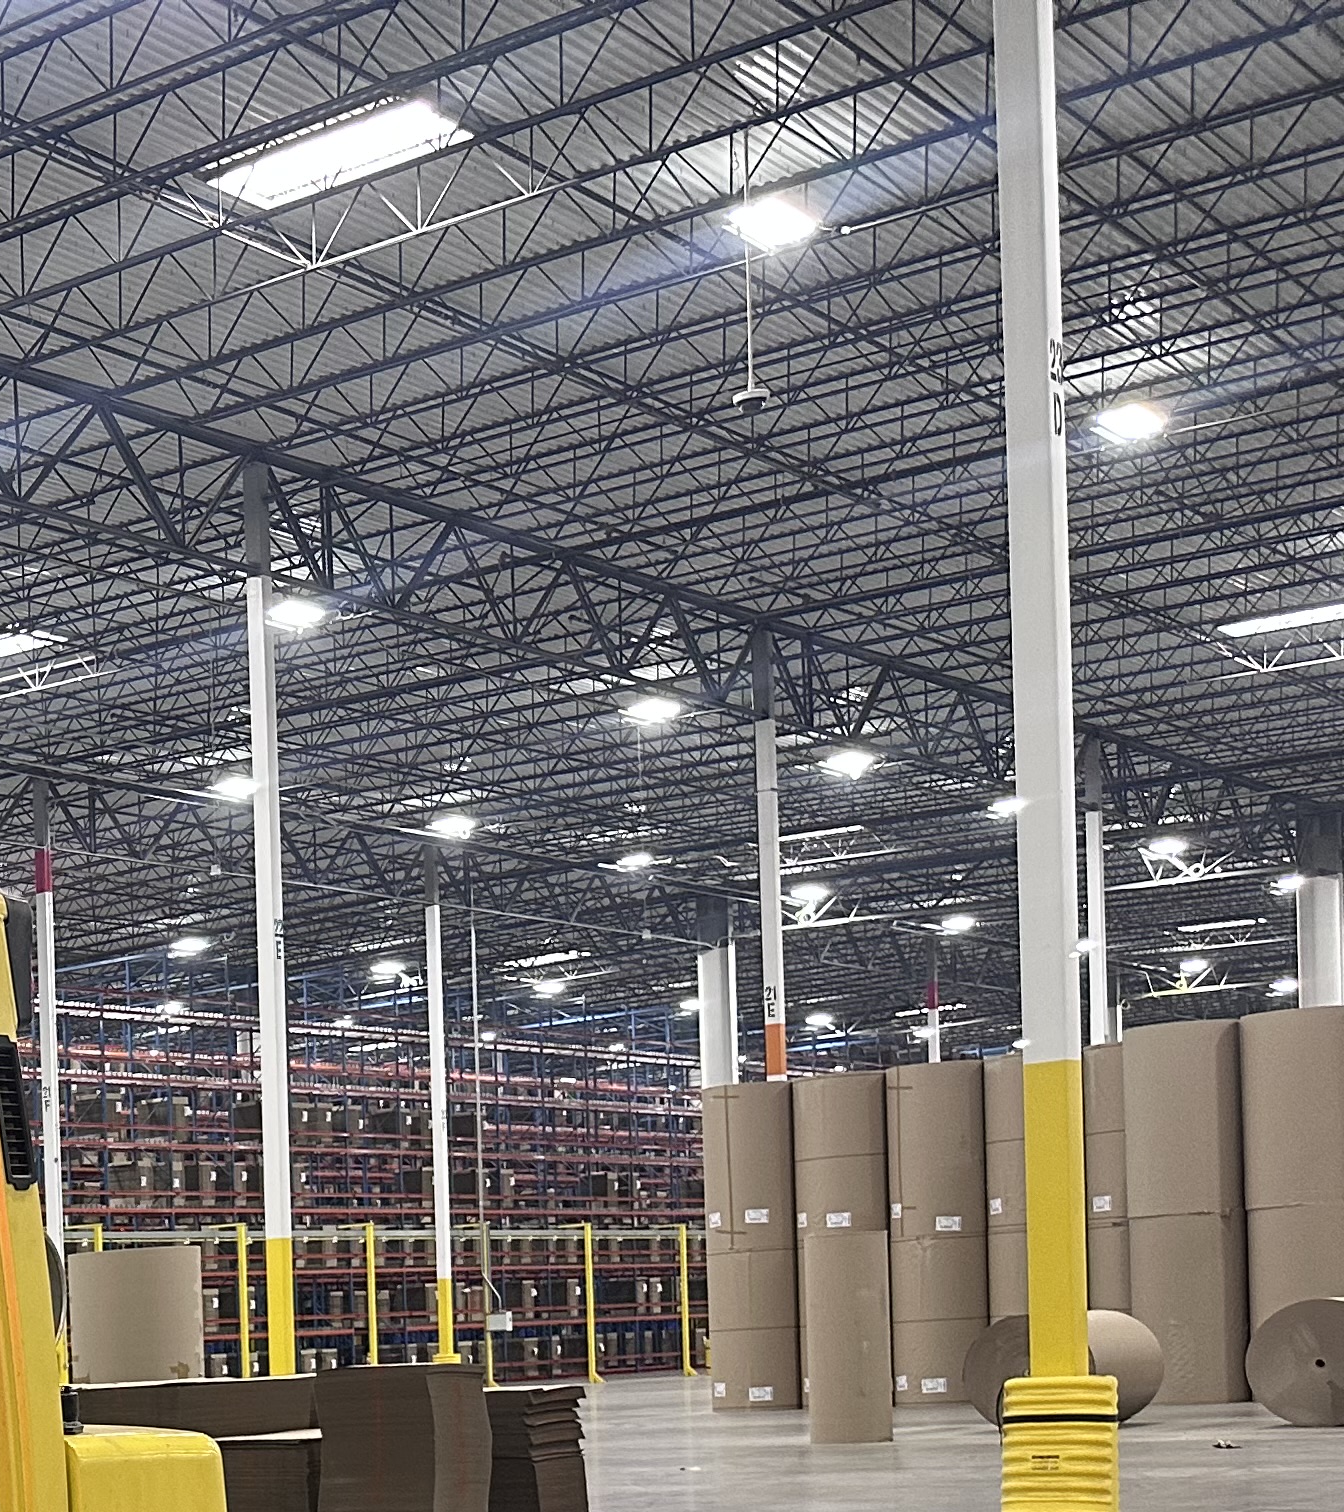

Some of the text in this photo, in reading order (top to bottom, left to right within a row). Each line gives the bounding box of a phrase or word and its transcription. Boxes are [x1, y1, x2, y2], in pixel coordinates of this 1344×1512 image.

[1054, 392, 1062, 436] D
[765, 986, 776, 1000] 21
[768, 1003, 775, 1017] E
